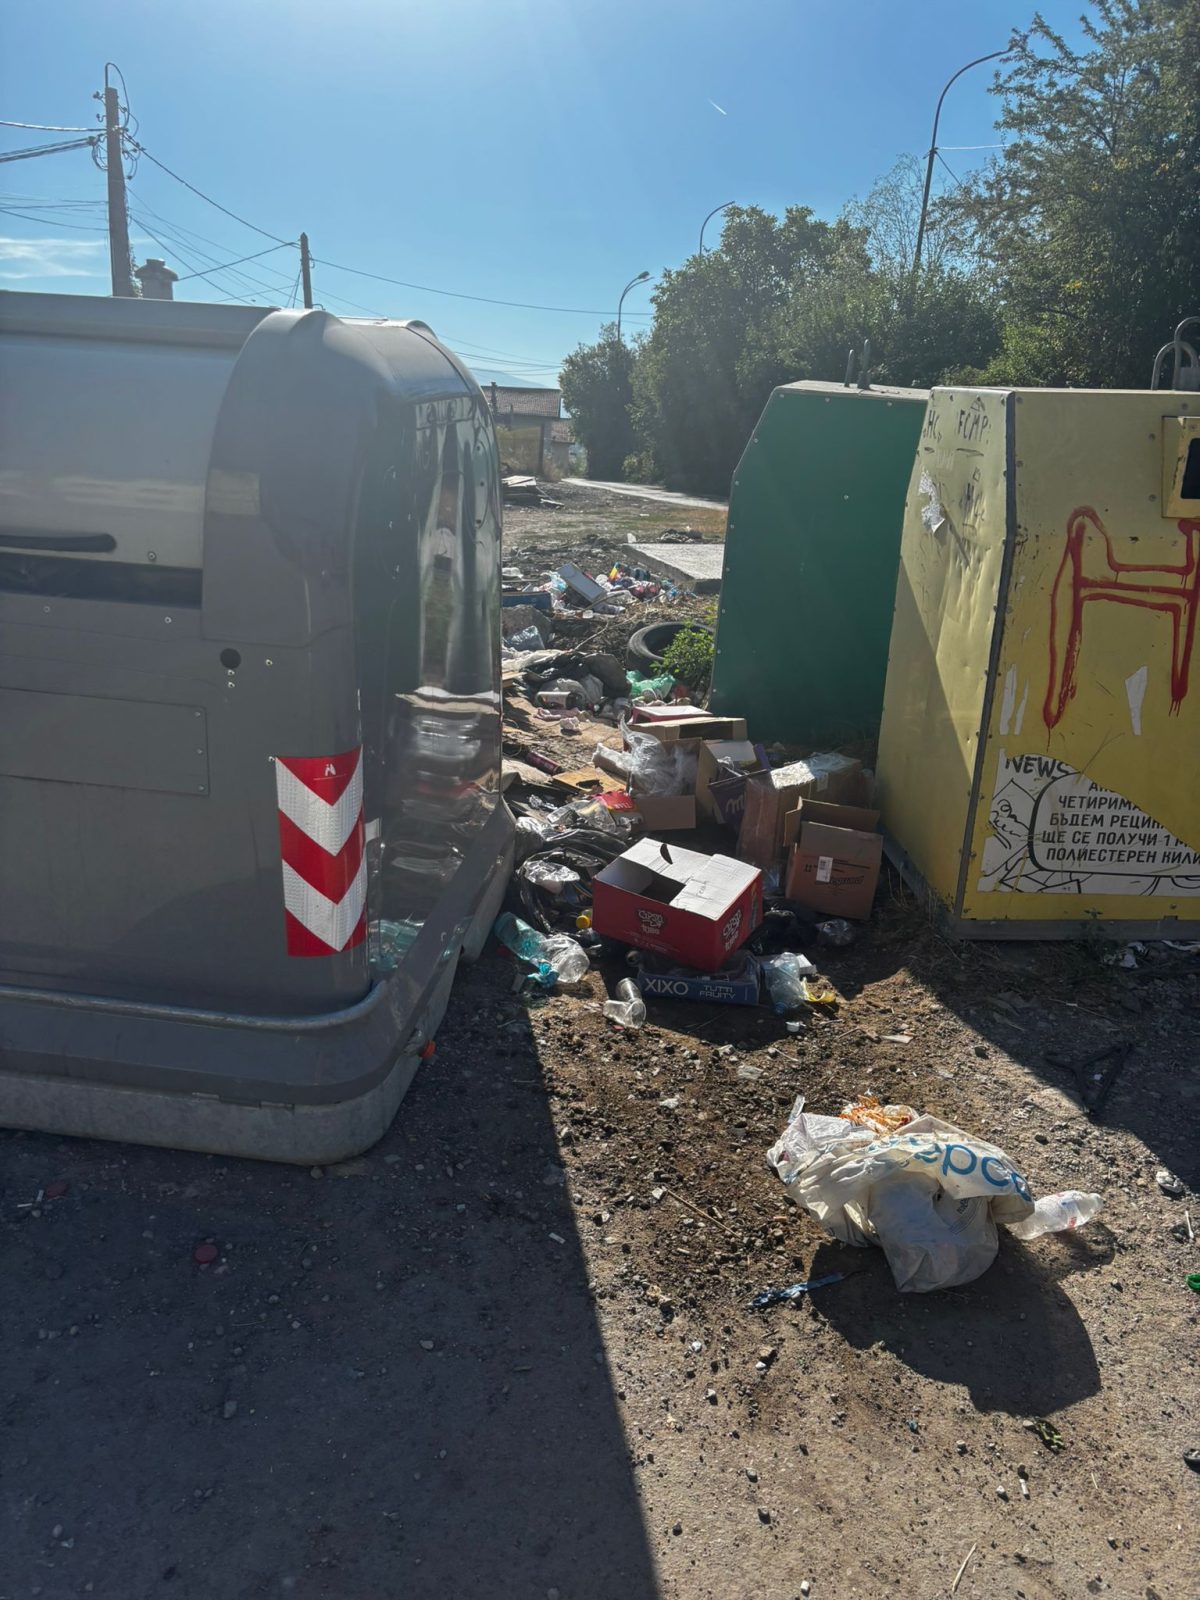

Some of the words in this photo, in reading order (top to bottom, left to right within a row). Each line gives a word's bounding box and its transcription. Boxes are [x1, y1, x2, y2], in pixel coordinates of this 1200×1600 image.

[1050, 812, 1104, 827] БЪДЕМ
[1071, 830, 1092, 844] СЕ
[1096, 831, 1158, 846] ПОЛУЧИ
[1163, 834, 1171, 847] 1
[1046, 847, 1157, 863] ПОЛИЕСТЕРЕН
[644, 977, 689, 996] XIXO
[699, 990, 736, 1000] FRUITY
